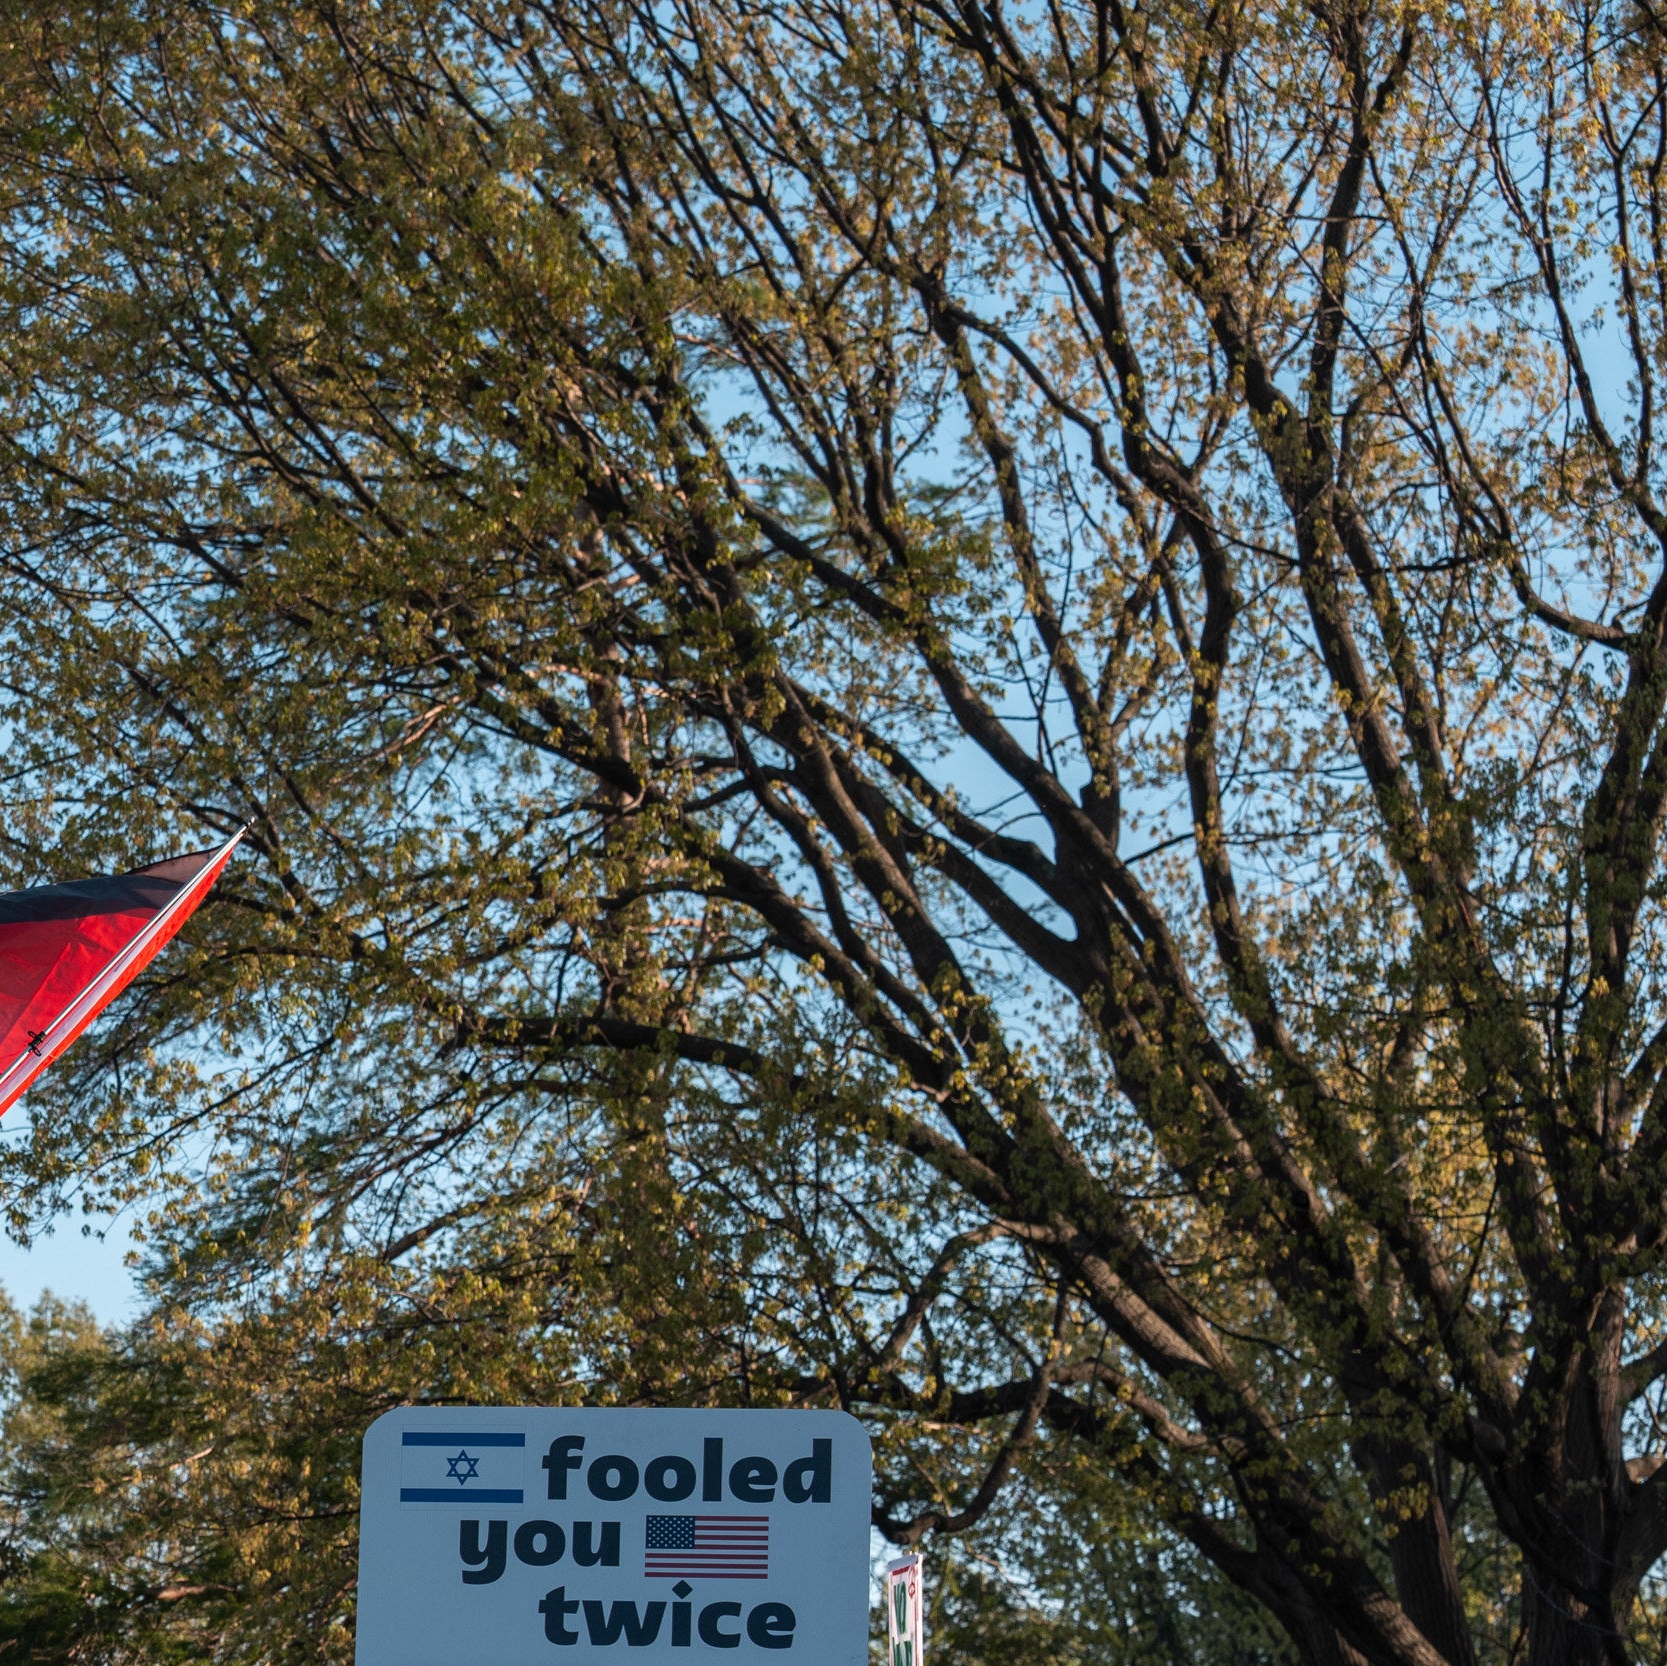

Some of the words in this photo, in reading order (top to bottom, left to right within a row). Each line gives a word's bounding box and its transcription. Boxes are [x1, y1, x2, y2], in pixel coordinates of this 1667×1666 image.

[542, 1435, 832, 1503] fooled
[459, 1519, 621, 1585] you
[538, 1579, 797, 1649] twice
